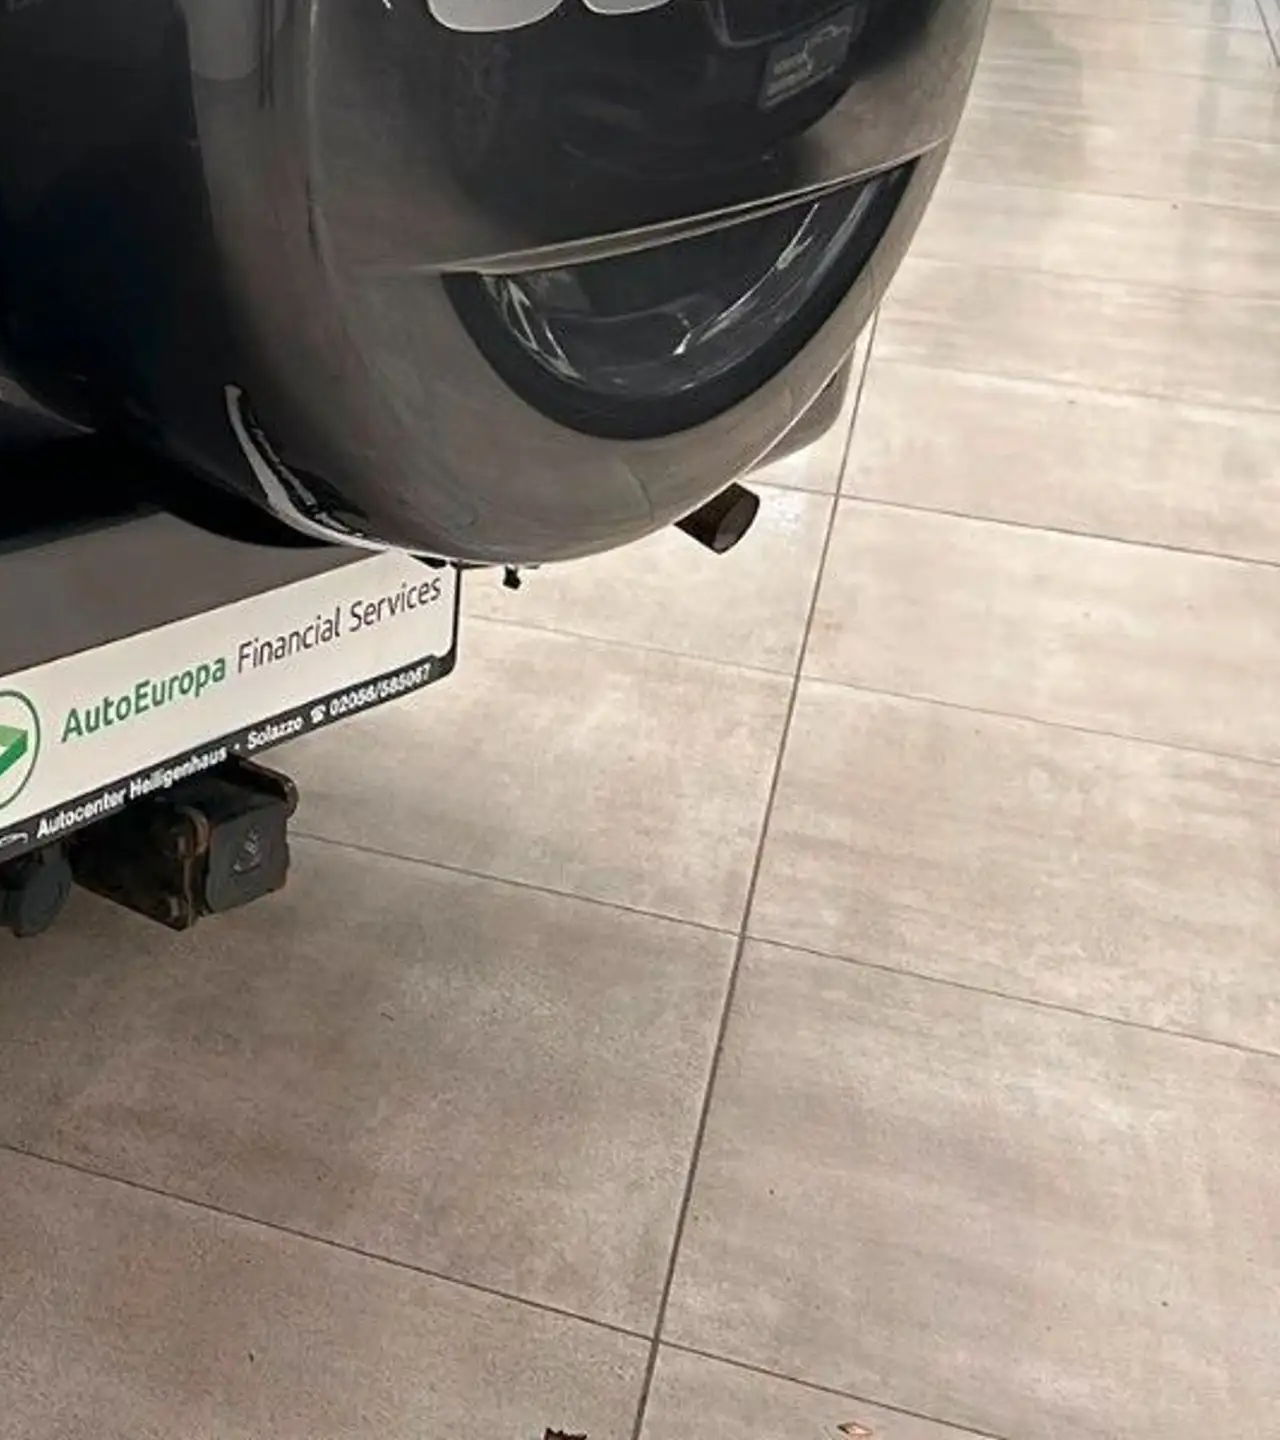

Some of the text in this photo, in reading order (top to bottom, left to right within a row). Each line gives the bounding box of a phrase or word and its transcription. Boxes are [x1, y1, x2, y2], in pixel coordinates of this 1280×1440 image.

[61, 577, 440, 743] AutoEuropa Financial Services
[37, 788, 127, 839] Autocenter
[129, 747, 228, 799] Heiligenhaus
[247, 717, 303, 750] Solazzo
